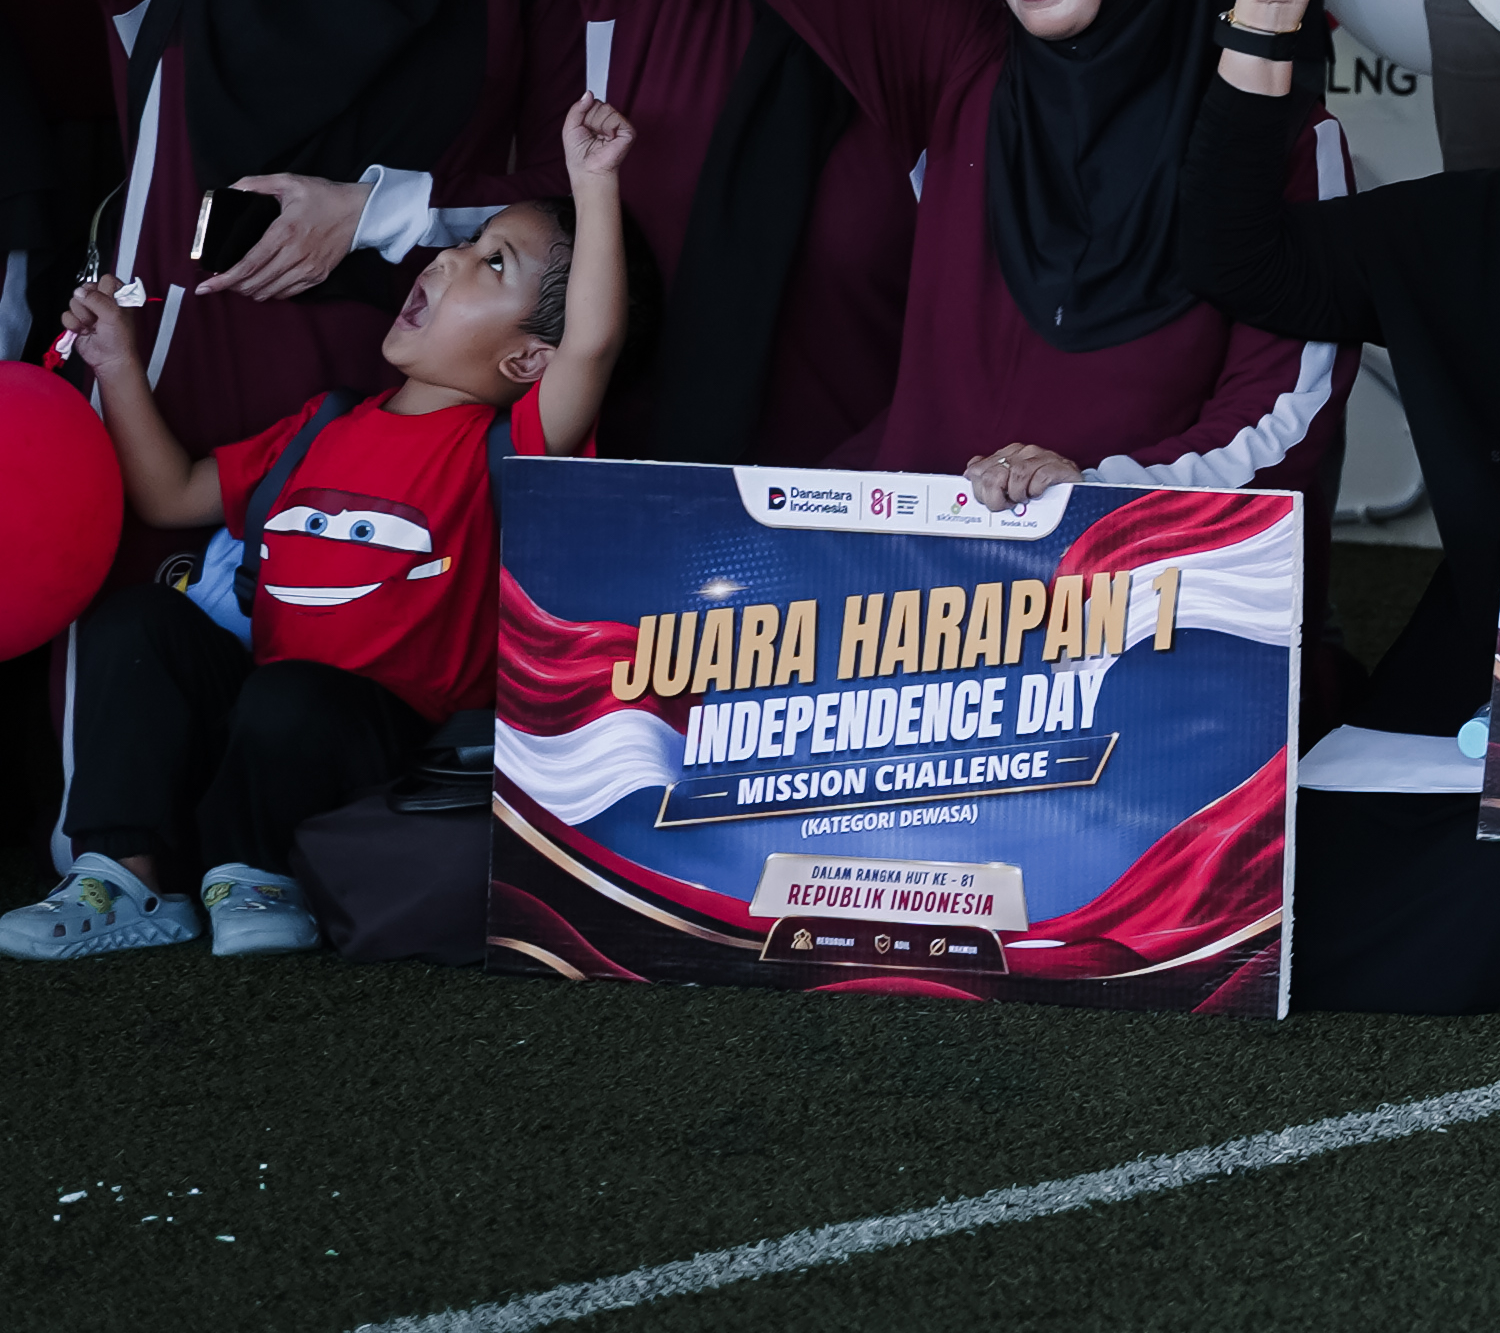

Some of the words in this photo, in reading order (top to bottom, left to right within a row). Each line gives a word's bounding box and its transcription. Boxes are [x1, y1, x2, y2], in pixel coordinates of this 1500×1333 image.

[1328, 57, 1418, 97] LNG
[789, 500, 848, 514] Indonesia
[790, 487, 852, 501] Danantara
[871, 488, 894, 519] 81
[611, 600, 818, 702] JUARA
[837, 570, 1133, 682] HARAPAN
[1152, 567, 1182, 652] 1
[682, 675, 1007, 767] INDEPENDENCE
[1016, 668, 1108, 736] DAY
[737, 769, 868, 807] MISSION
[874, 751, 1049, 794] CHALLENGE
[800, 809, 896, 840] (KATEGORI
[899, 802, 978, 832] DEWASA)
[811, 865, 851, 880] DALAM
[855, 868, 900, 883] RANGKA
[905, 870, 930, 885] HUT
[932, 872, 949, 886] KE
[960, 874, 974, 888] 81
[787, 883, 886, 910] REPUBLIK
[890, 889, 994, 916] INDONESIA
